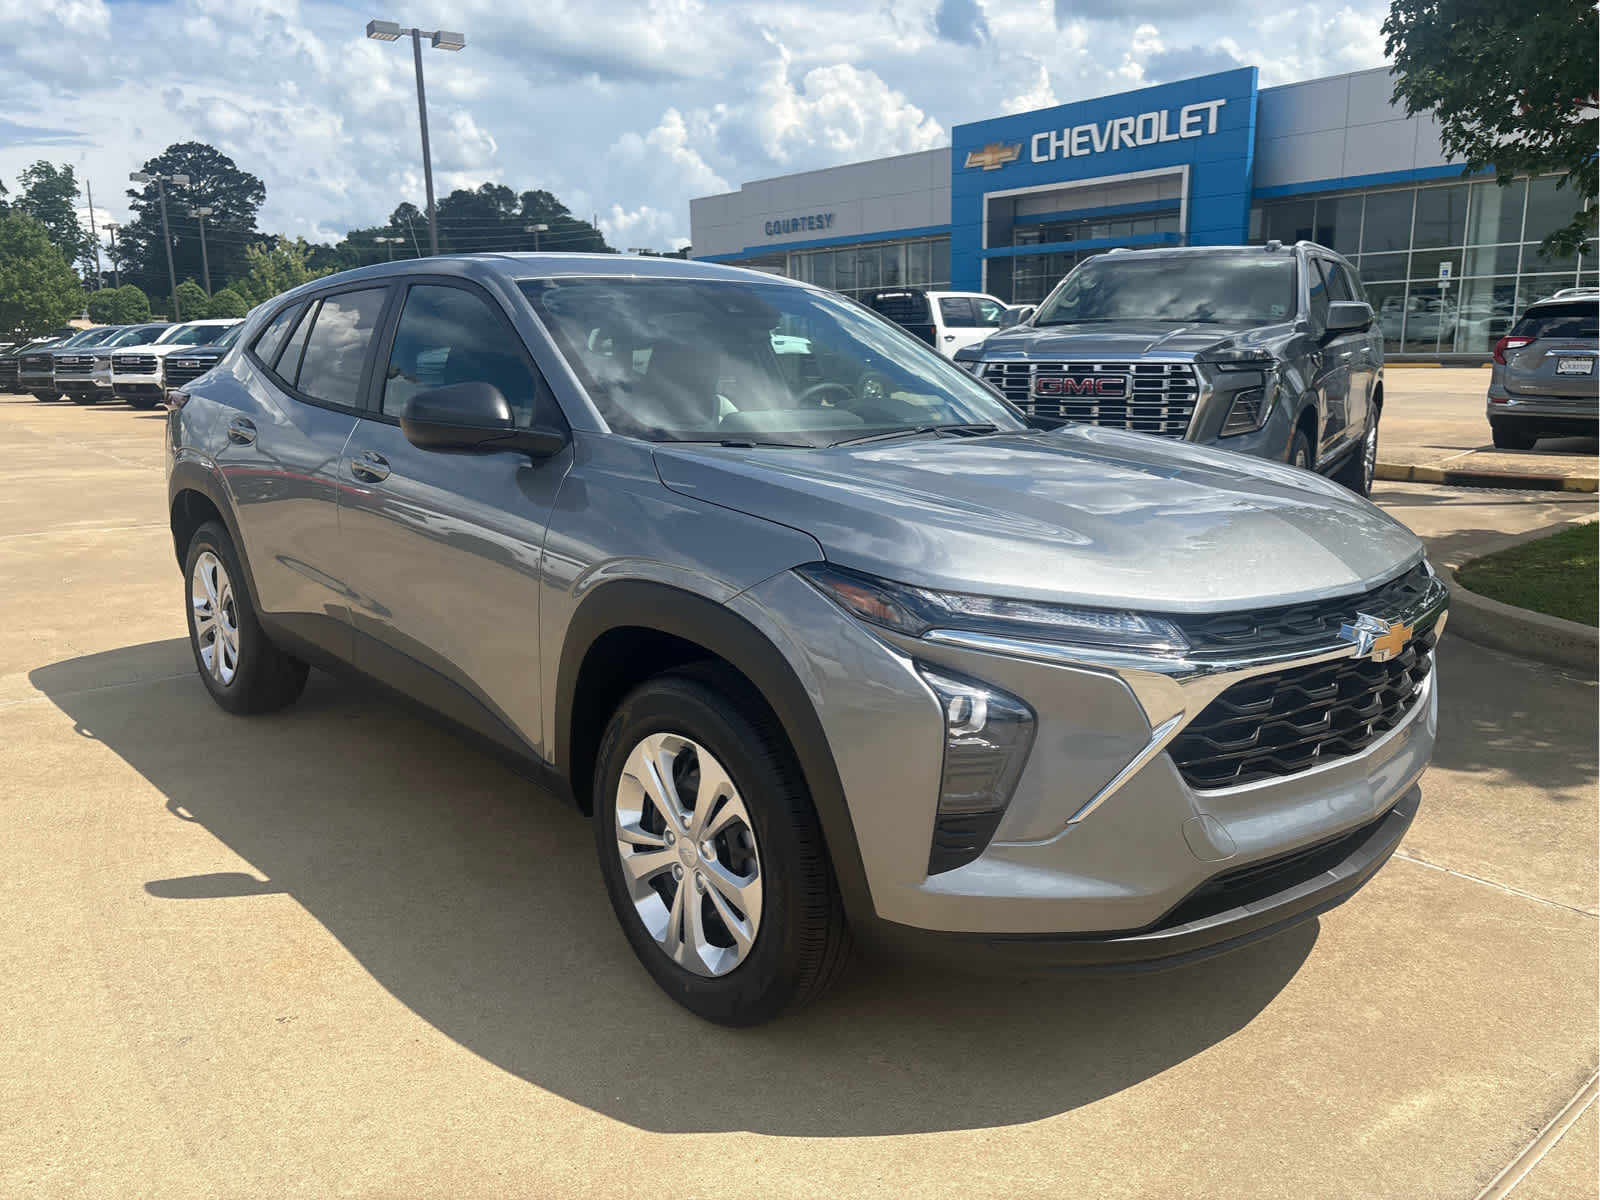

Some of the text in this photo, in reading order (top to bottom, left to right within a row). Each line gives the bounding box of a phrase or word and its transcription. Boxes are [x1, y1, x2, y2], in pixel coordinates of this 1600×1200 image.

[1031, 98, 1226, 163] CHEVROLET
[765, 213, 834, 236] COURTESY
[1036, 377, 1124, 395] GMC
